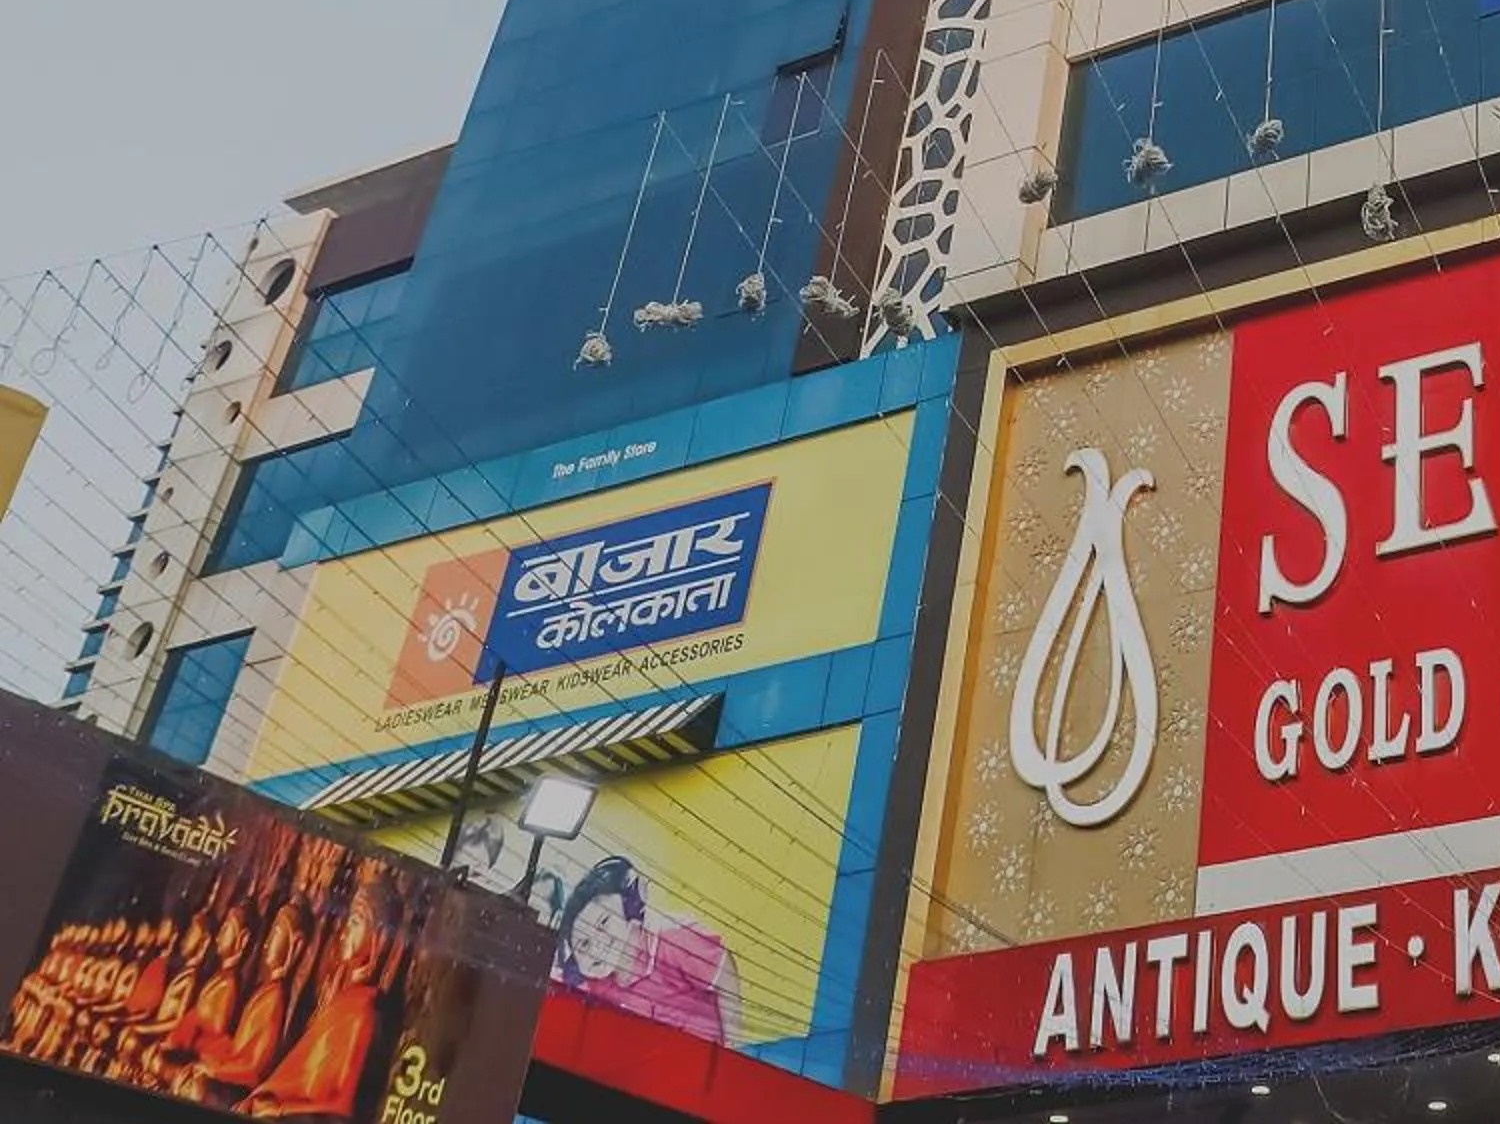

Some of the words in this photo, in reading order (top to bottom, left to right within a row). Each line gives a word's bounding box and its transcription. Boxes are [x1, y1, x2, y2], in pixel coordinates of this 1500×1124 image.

[552, 462, 574, 479] The
[577, 449, 621, 473] Family
[624, 441, 658, 460] Store
[513, 512, 750, 603] बाजार
[536, 572, 736, 650] कोलकाता
[375, 699, 463, 733] LADIESWEAR
[469, 679, 549, 713] MESWEAR
[556, 660, 631, 691] KIDSWEAR
[639, 633, 745, 672] ACCESSORIES
[1254, 646, 1466, 782] GOLD
[1033, 902, 1380, 1056] ANTIQUE
[395, 1044, 446, 1106] 3rd
